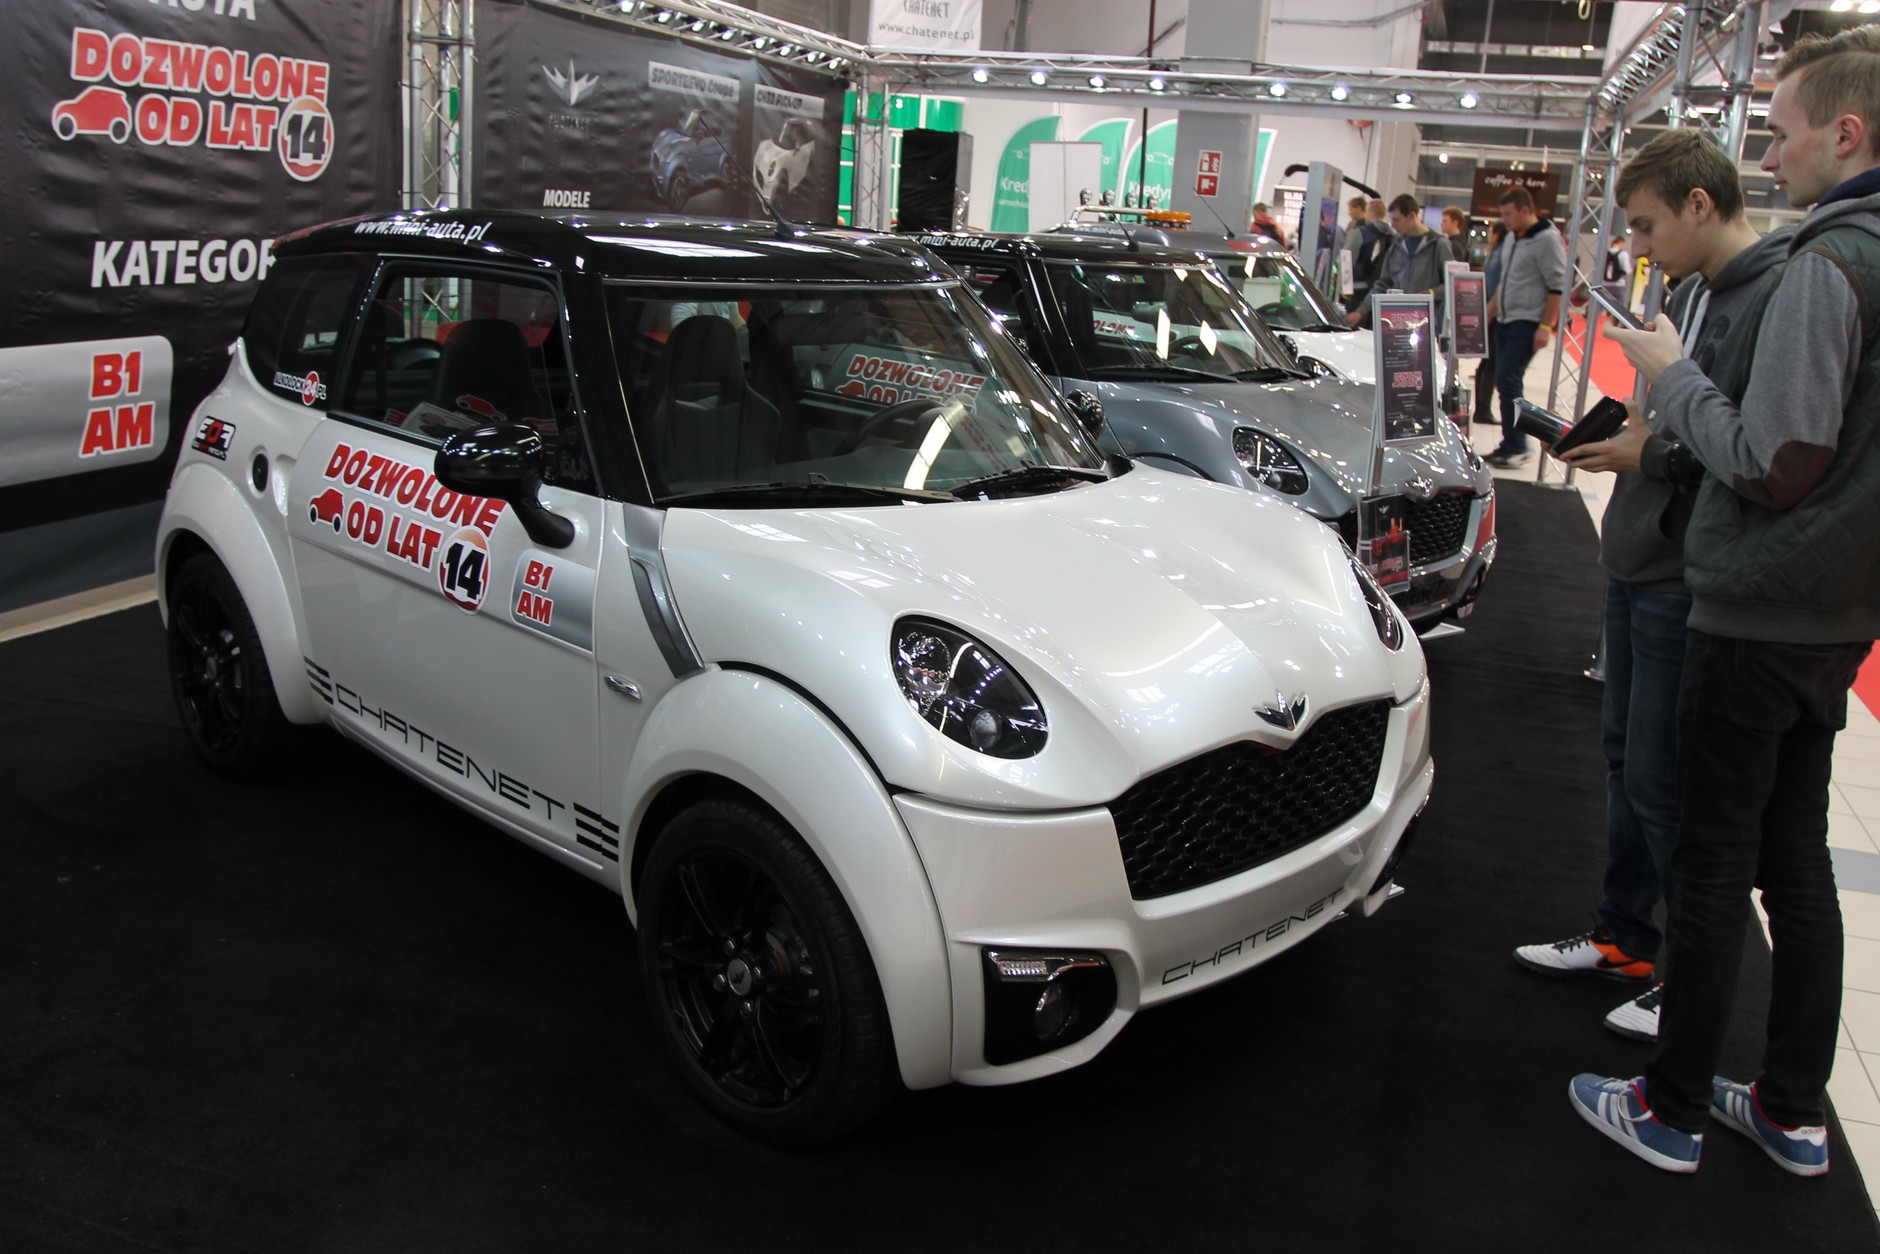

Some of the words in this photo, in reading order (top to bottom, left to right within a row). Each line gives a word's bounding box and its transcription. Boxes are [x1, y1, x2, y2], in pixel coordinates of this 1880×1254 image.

[878, 23, 975, 42] www.chatenet.pl
[72, 28, 329, 103] DOZWOLONE
[136, 93, 203, 146] OD
[206, 100, 279, 152] LAT
[287, 114, 327, 161] 14
[543, 188, 591, 209] MODELE
[89, 351, 142, 400] B1
[846, 354, 988, 400] DOZWOLONE
[79, 401, 155, 458] AM
[324, 441, 507, 537] DOZWOLONE
[345, 500, 385, 548] OD
[386, 514, 443, 572] LAT
[445, 542, 486, 600] 14
[523, 558, 554, 591] B1
[516, 589, 553, 626] AM
[335, 682, 565, 820] CHATENET
[1162, 887, 1344, 985] CHATENET
